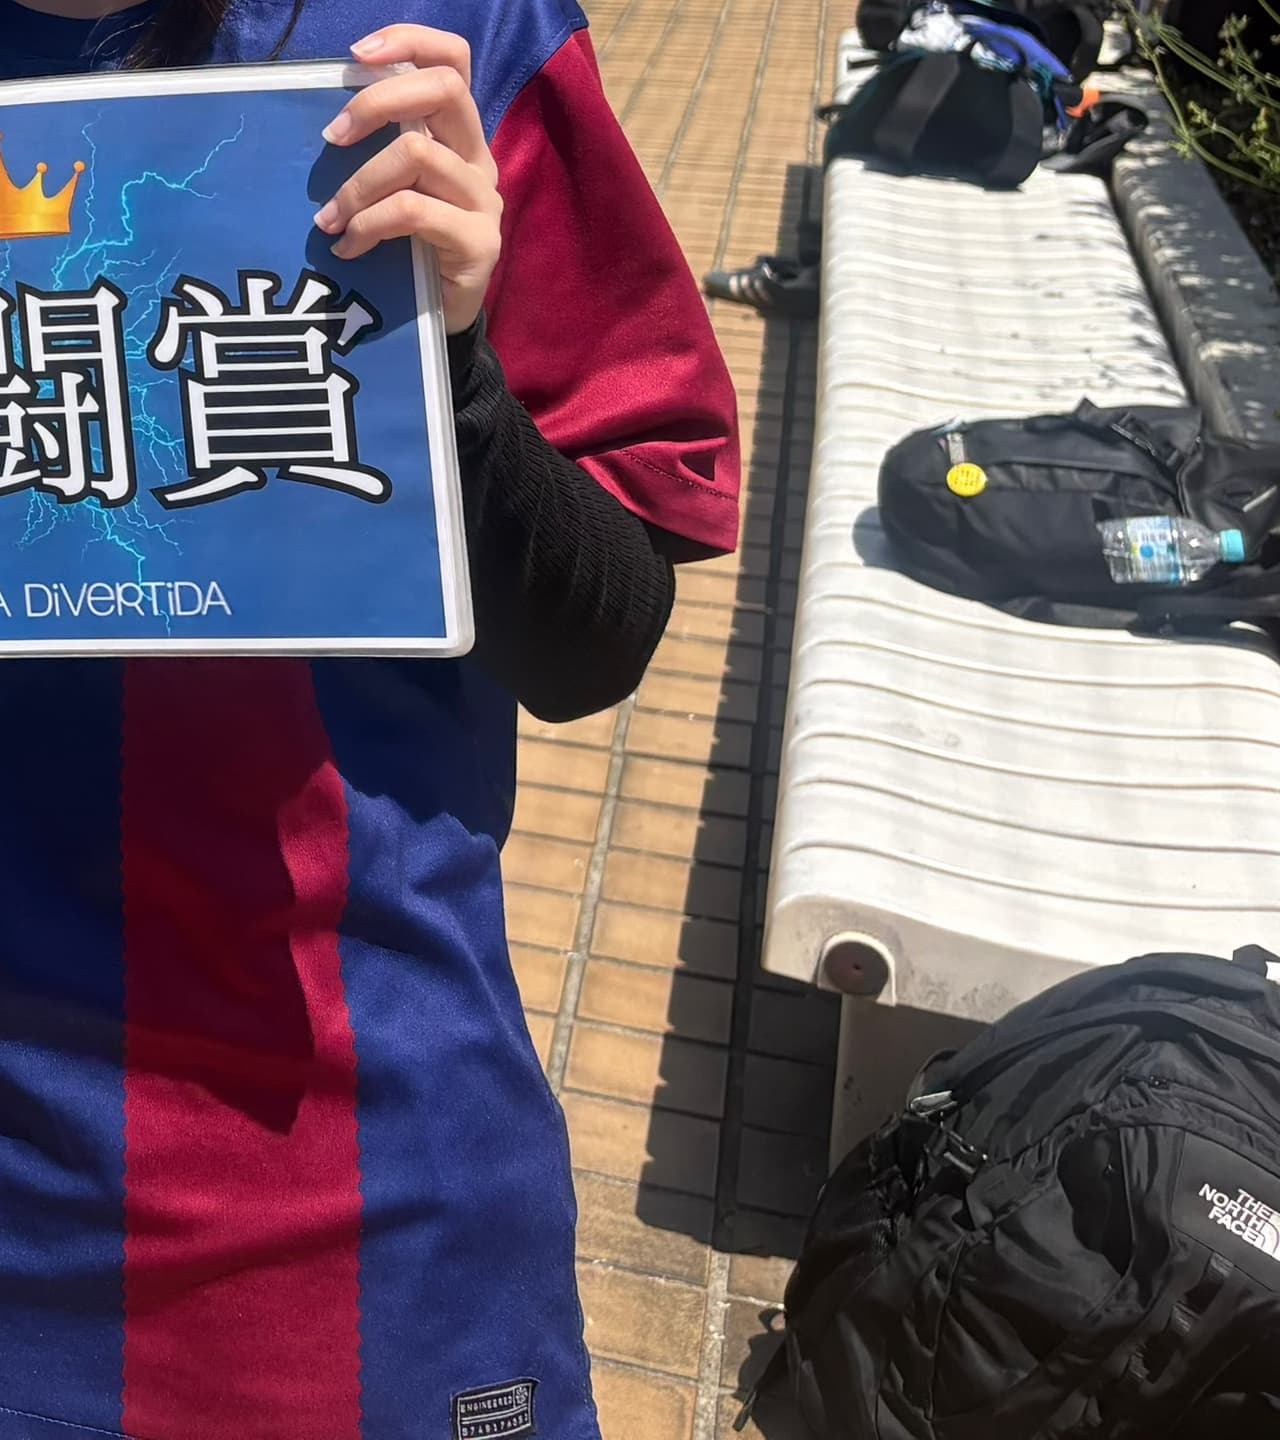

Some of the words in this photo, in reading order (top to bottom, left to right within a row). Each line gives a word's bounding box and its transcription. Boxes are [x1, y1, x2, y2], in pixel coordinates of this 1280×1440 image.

[1198, 1183, 1266, 1231] NORTH
[1237, 1188, 1274, 1220] THE
[1208, 1205, 1260, 1244] FACE
[460, 1395, 513, 1414] ENGINEERED
